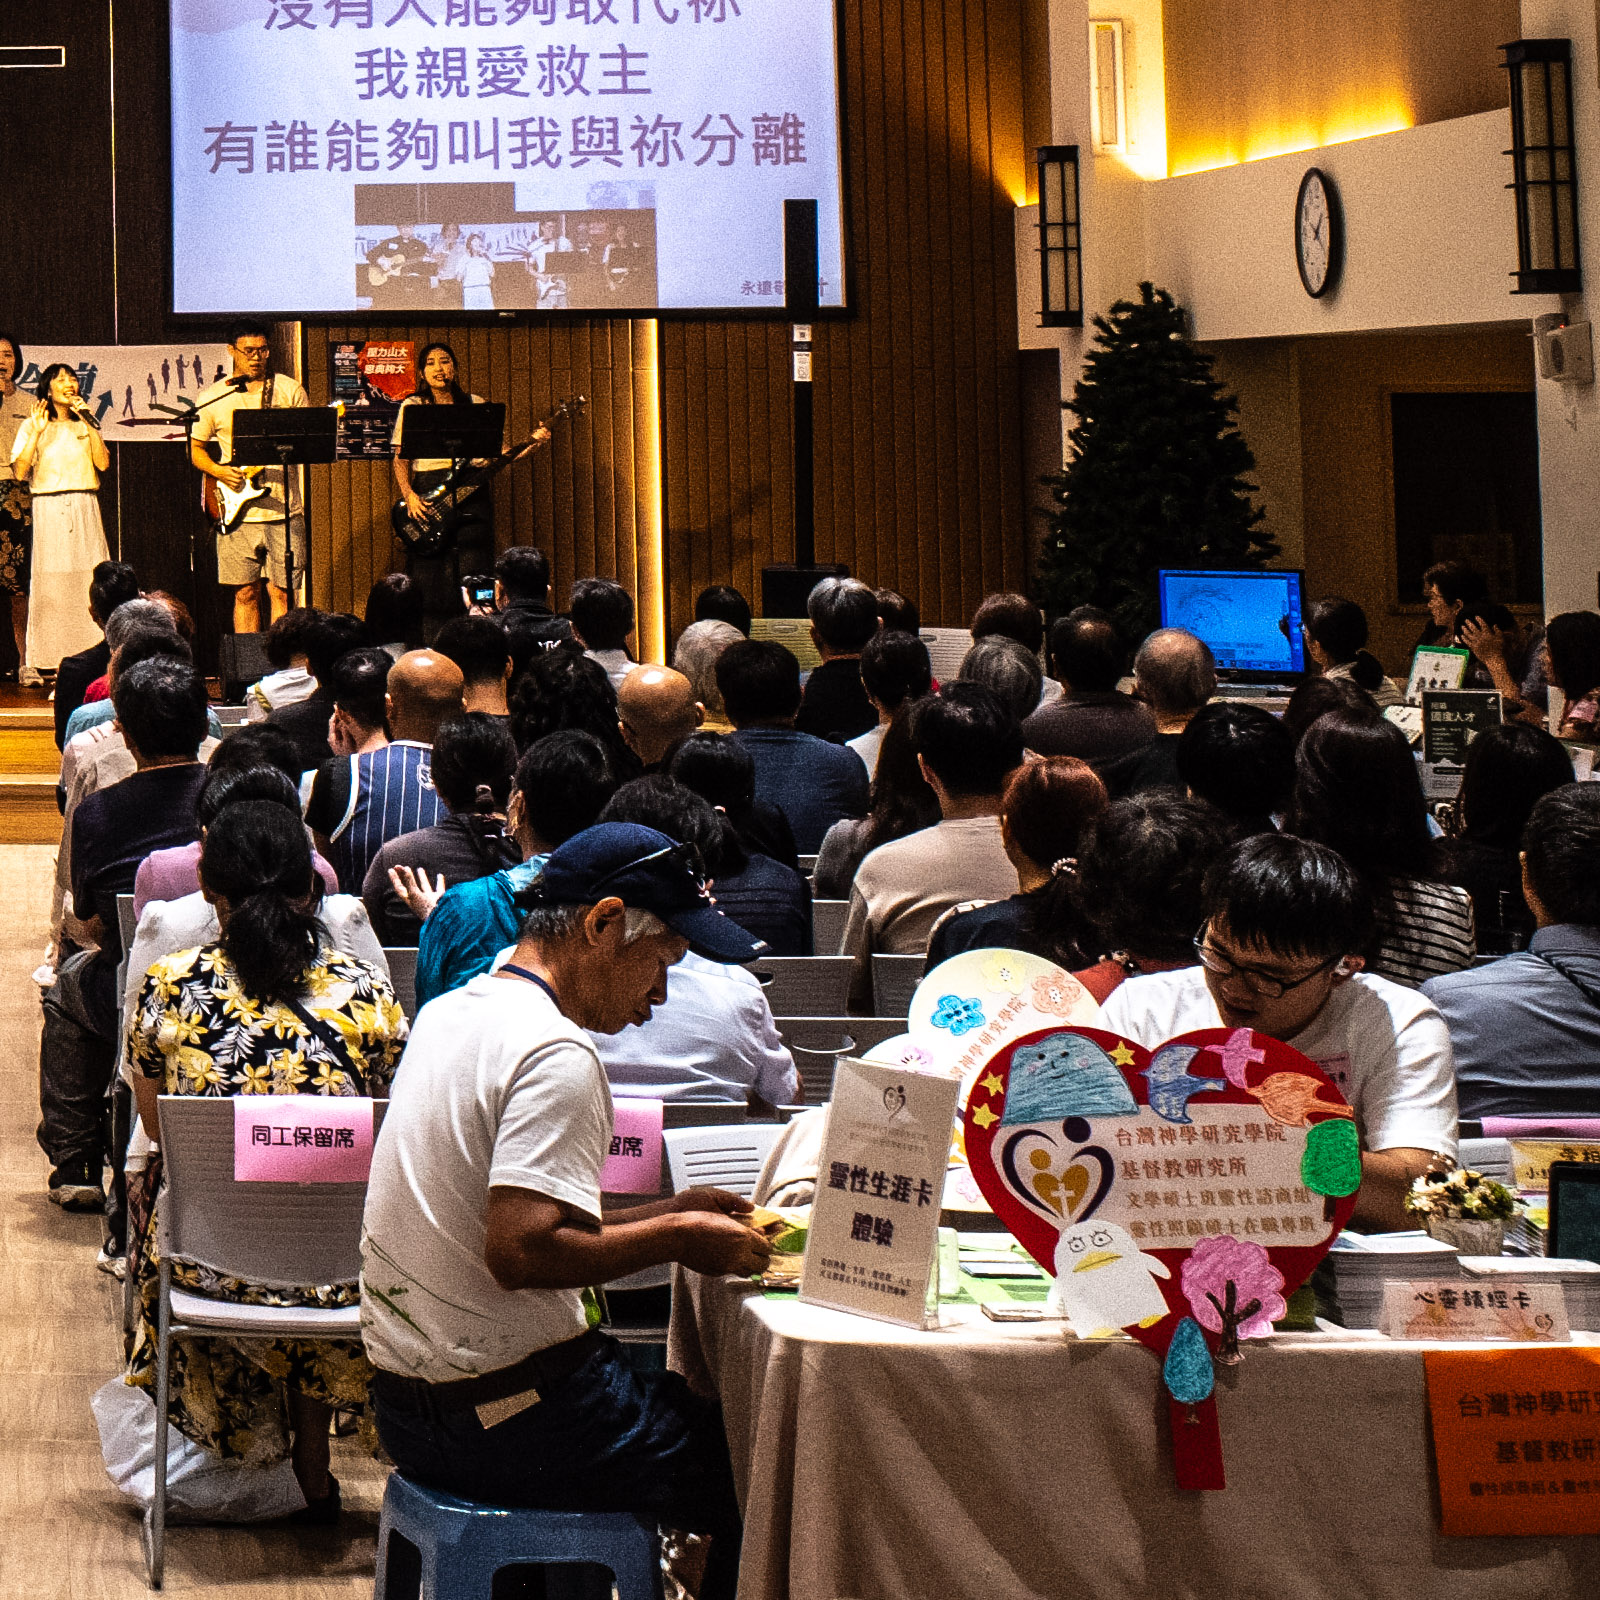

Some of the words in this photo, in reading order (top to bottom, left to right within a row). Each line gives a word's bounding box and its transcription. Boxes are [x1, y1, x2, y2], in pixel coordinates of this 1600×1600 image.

[353, 41, 653, 100] 我親愛救主
[203, 110, 808, 175] 有誰能夠叫我與祢分離
[250, 1124, 355, 1149] 同工保留席
[1115, 1121, 1288, 1147] 台灣神學研究學院
[827, 1160, 934, 1208] 靈性生涯卡
[1120, 1156, 1247, 1180] 基督教研究所
[850, 1211, 895, 1248] 體驗
